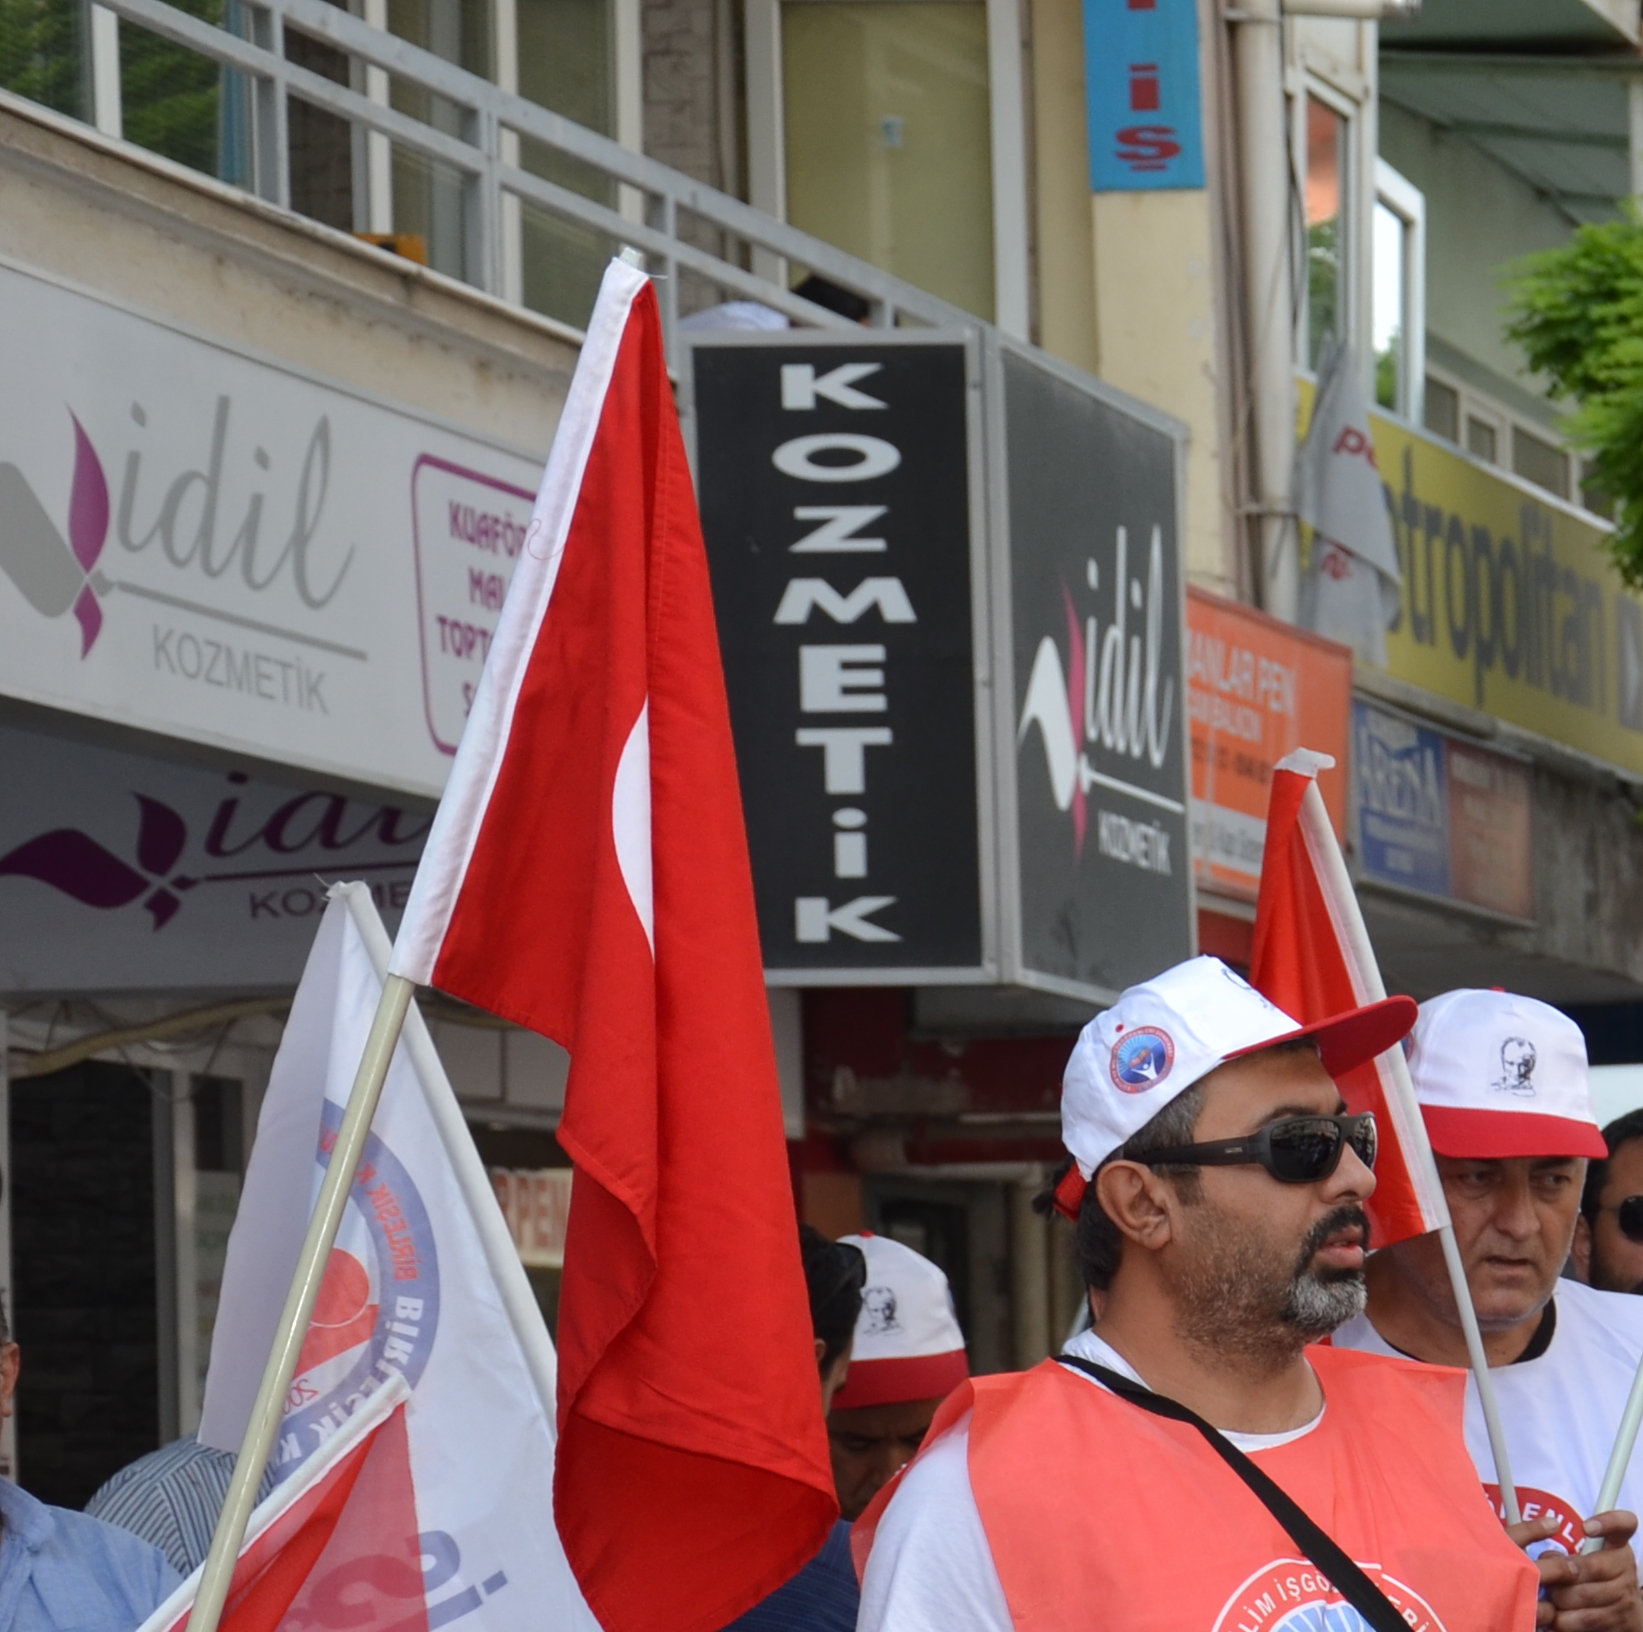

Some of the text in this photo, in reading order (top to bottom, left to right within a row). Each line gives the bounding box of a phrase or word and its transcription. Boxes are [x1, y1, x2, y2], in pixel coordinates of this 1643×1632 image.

[117, 396, 355, 611] idil
[1385, 441, 1612, 715] tropolitan
[153, 623, 330, 715] KOZMETİK
[1086, 523, 1175, 769] idil
